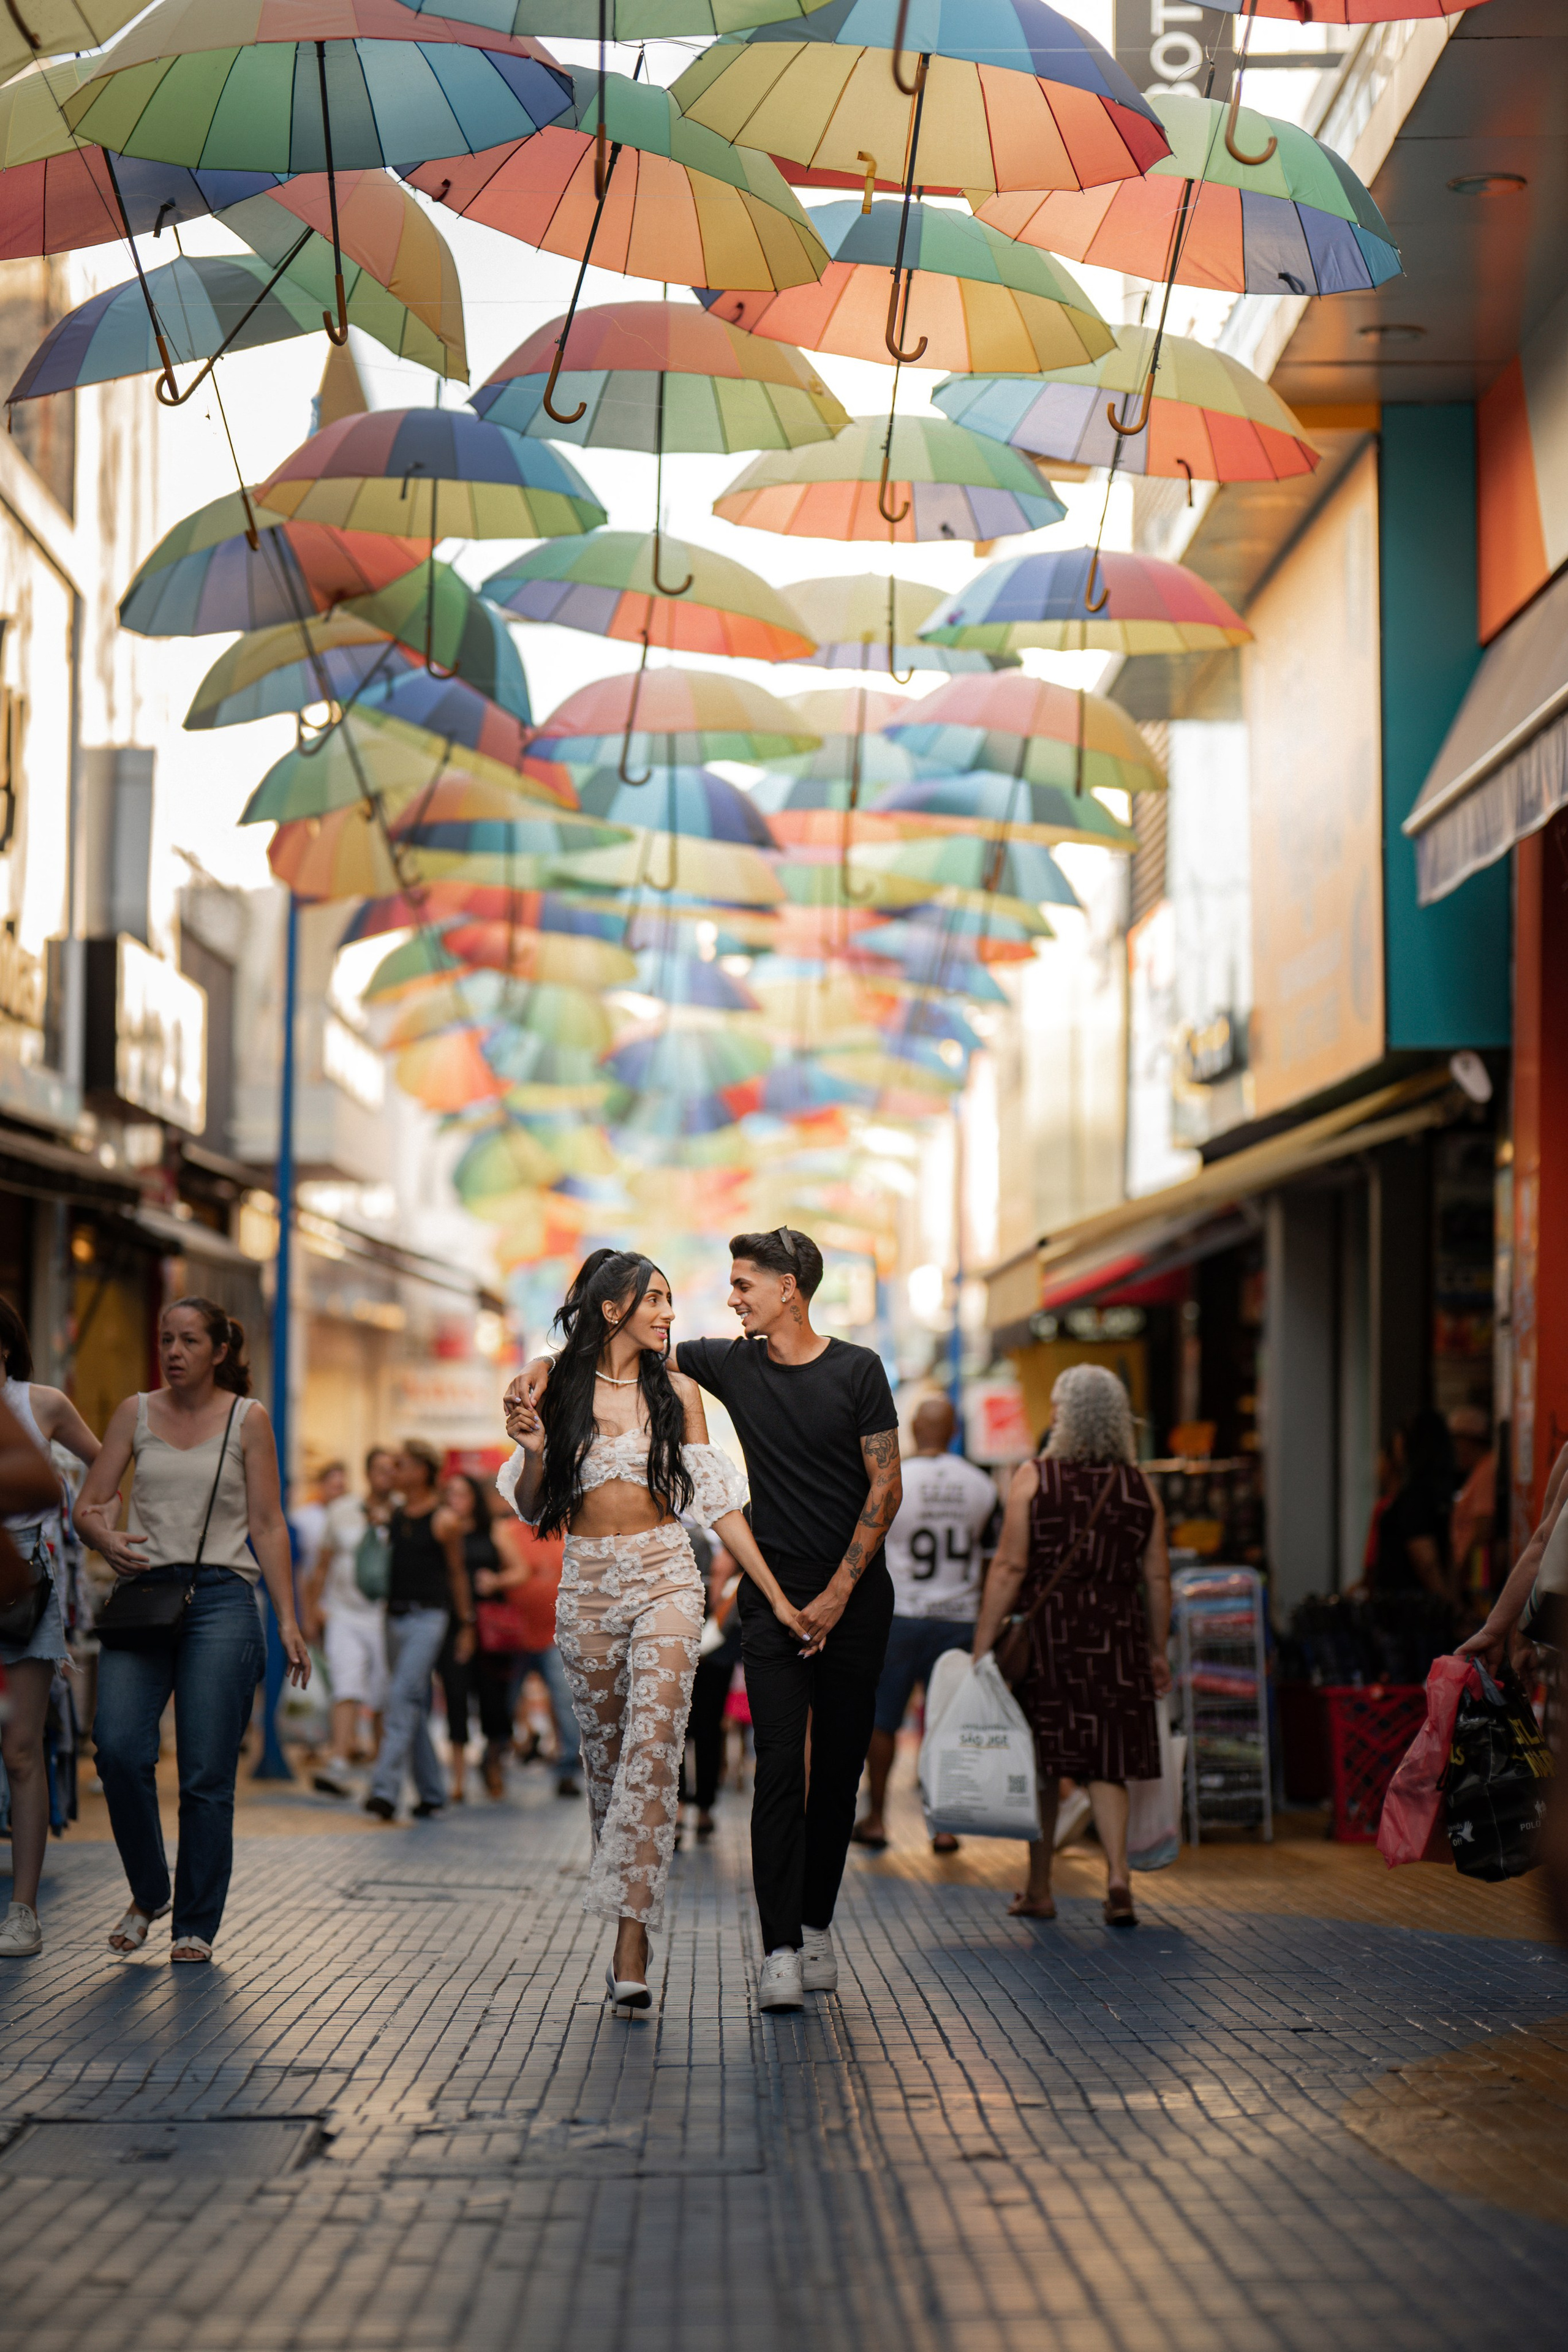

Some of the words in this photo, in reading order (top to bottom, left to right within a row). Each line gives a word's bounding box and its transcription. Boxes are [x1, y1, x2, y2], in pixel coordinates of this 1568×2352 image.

[910, 1528, 971, 1581] 94
[1520, 1820, 1540, 1831] POLO
[1453, 1838, 1463, 1846] Off
